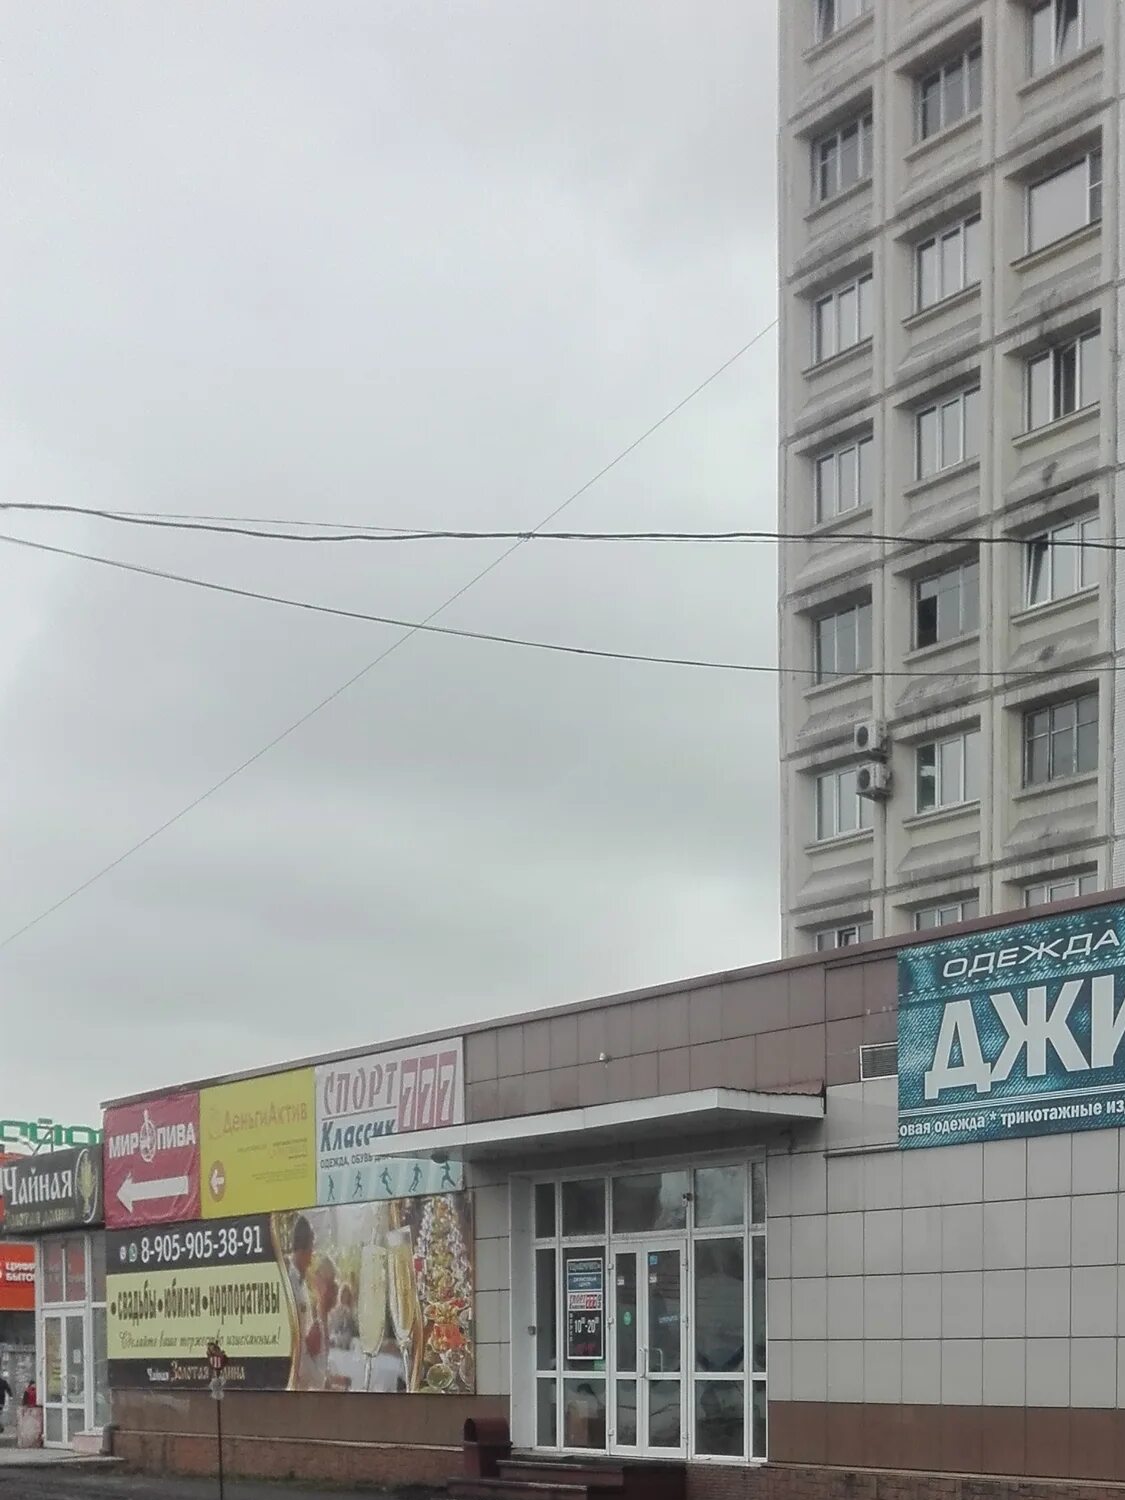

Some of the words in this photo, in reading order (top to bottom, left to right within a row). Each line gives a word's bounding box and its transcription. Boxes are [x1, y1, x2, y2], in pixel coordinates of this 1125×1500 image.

[943, 928, 1121, 981] ОДЕЖДА
[324, 1062, 398, 1115] СПОРТ
[402, 1062, 456, 1129] 777
[935, 1115, 985, 1136] одежда
[1001, 1099, 1102, 1128] трикотажные
[109, 1132, 139, 1159] МИР
[157, 1122, 195, 1150] ПИВА
[3, 1167, 72, 1205] Чайная
[141, 1225, 263, 1263] 8-905-905-38-91
[209, 1281, 280, 1325] корпоративы
